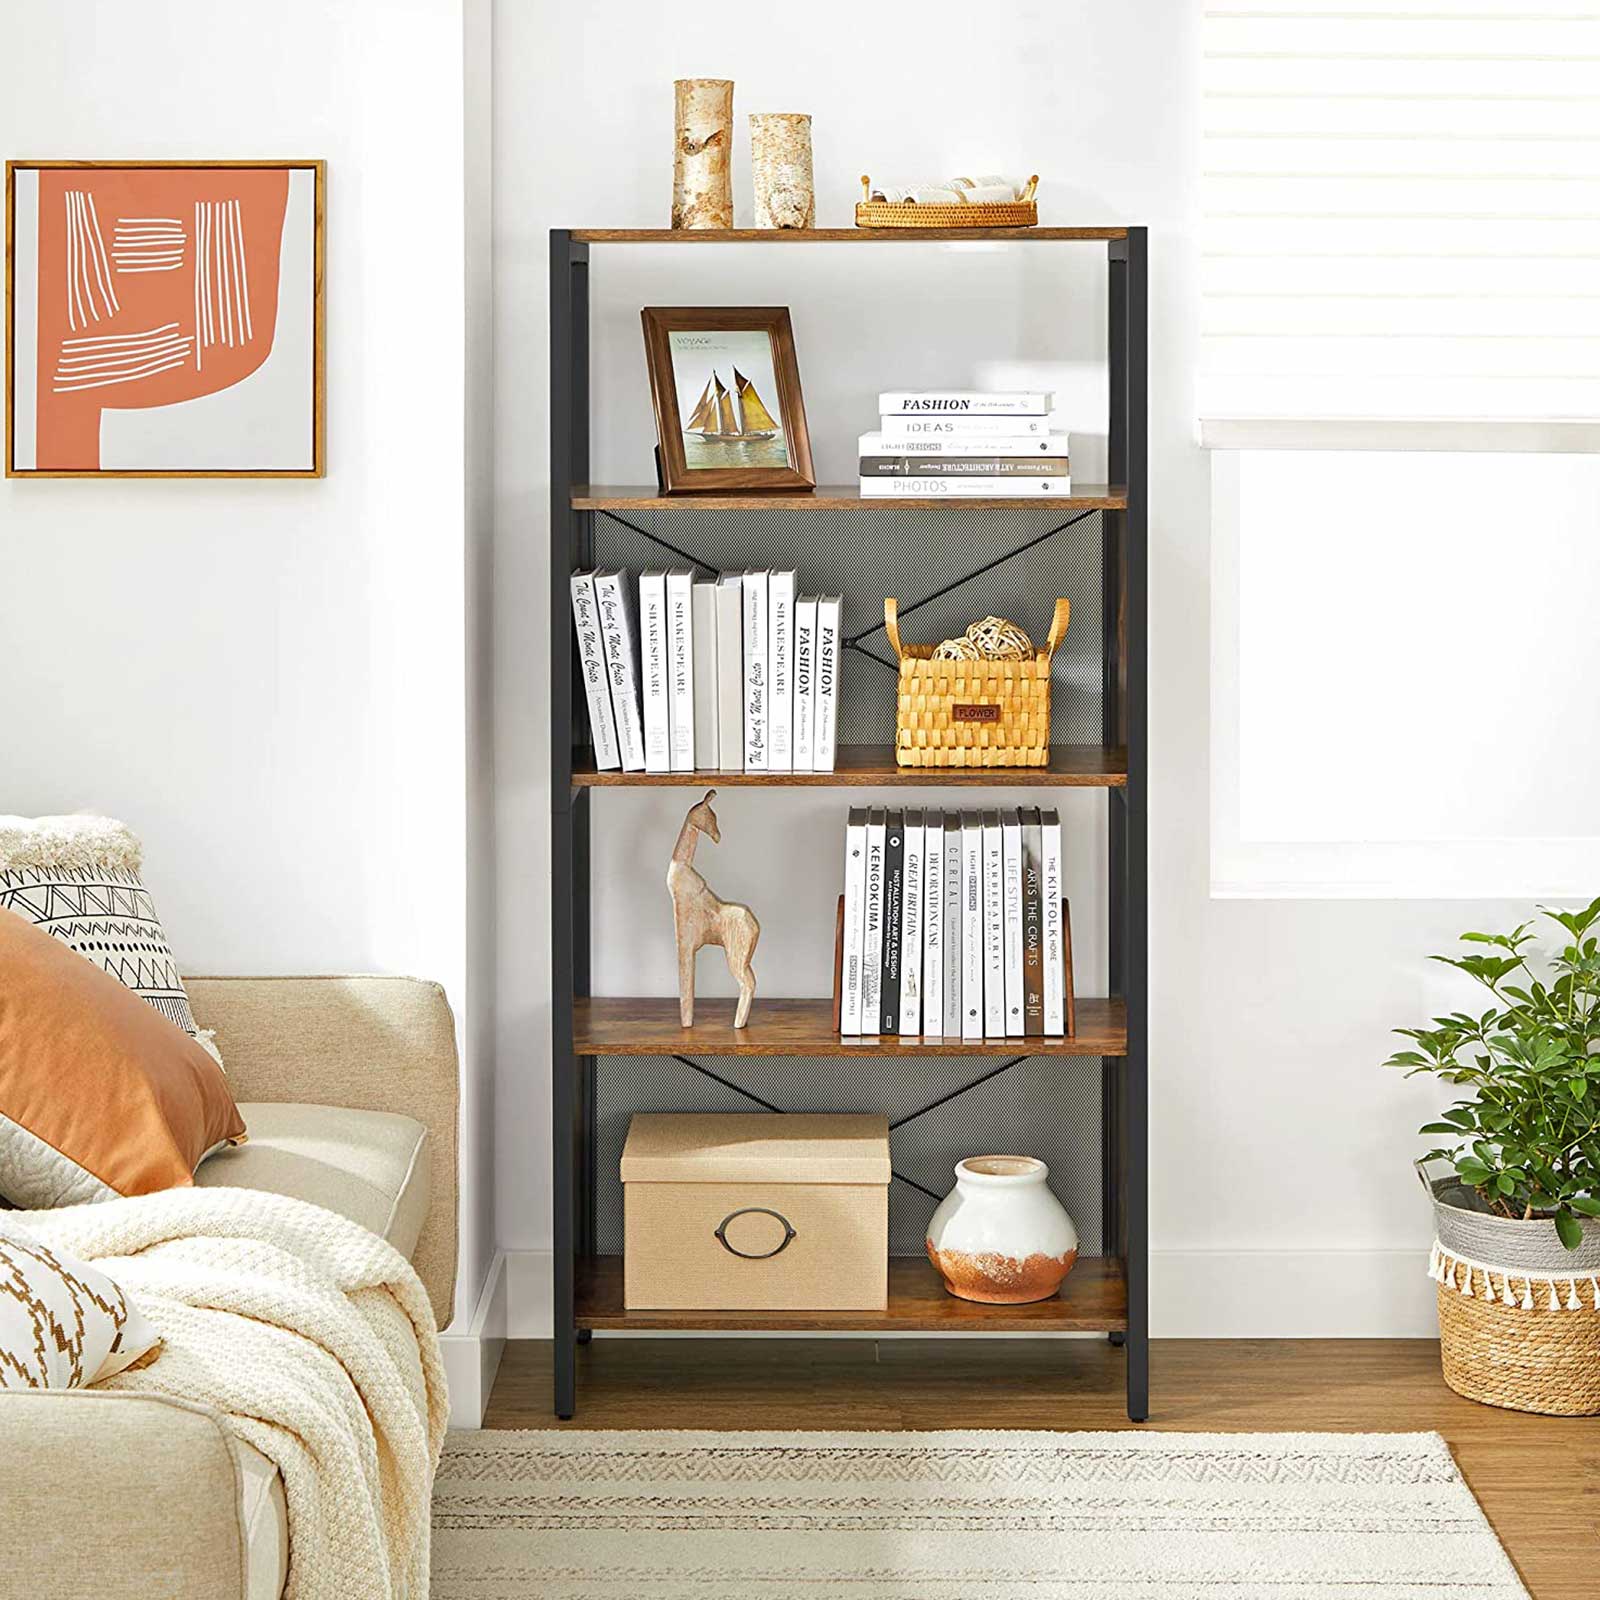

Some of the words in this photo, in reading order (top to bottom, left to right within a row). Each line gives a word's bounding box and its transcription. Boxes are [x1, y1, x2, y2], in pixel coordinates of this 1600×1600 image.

[902, 400, 970, 410] FASHION
[906, 423, 954, 432] IDEAS
[894, 481, 948, 492] PHOTOS
[576, 582, 588, 596] The
[602, 585, 614, 598] The
[576, 598, 590, 619] Count
[602, 601, 617, 621] Count
[583, 631, 596, 657] Monte
[609, 634, 622, 659] Monte
[648, 603, 659, 697] SHAKESPEARE
[675, 602, 685, 695] SHAKESPEARE
[776, 602, 785, 696] SHAKESPEARE
[584, 660, 600, 683] Cristo
[610, 662, 625, 686] Cristo
[799, 627, 810, 696] FASHION
[822, 627, 833, 696] FASHION
[749, 663, 763, 687] Cristo
[749, 688, 762, 714] Monte
[959, 709, 994, 717] FLOWER
[749, 750, 762, 764] The
[908, 854, 918, 891] GREAT
[949, 847, 959, 907] CEREAL
[1028, 869, 1037, 895] ARTS
[891, 870, 900, 924] INSTALLATION
[969, 876, 977, 911] DESIGNS
[1048, 876, 1057, 937] KINFOLK
[907, 893, 917, 937] BRITAIN
[1028, 900, 1037, 921] THE
[1028, 926, 1037, 966] CRAFTS
